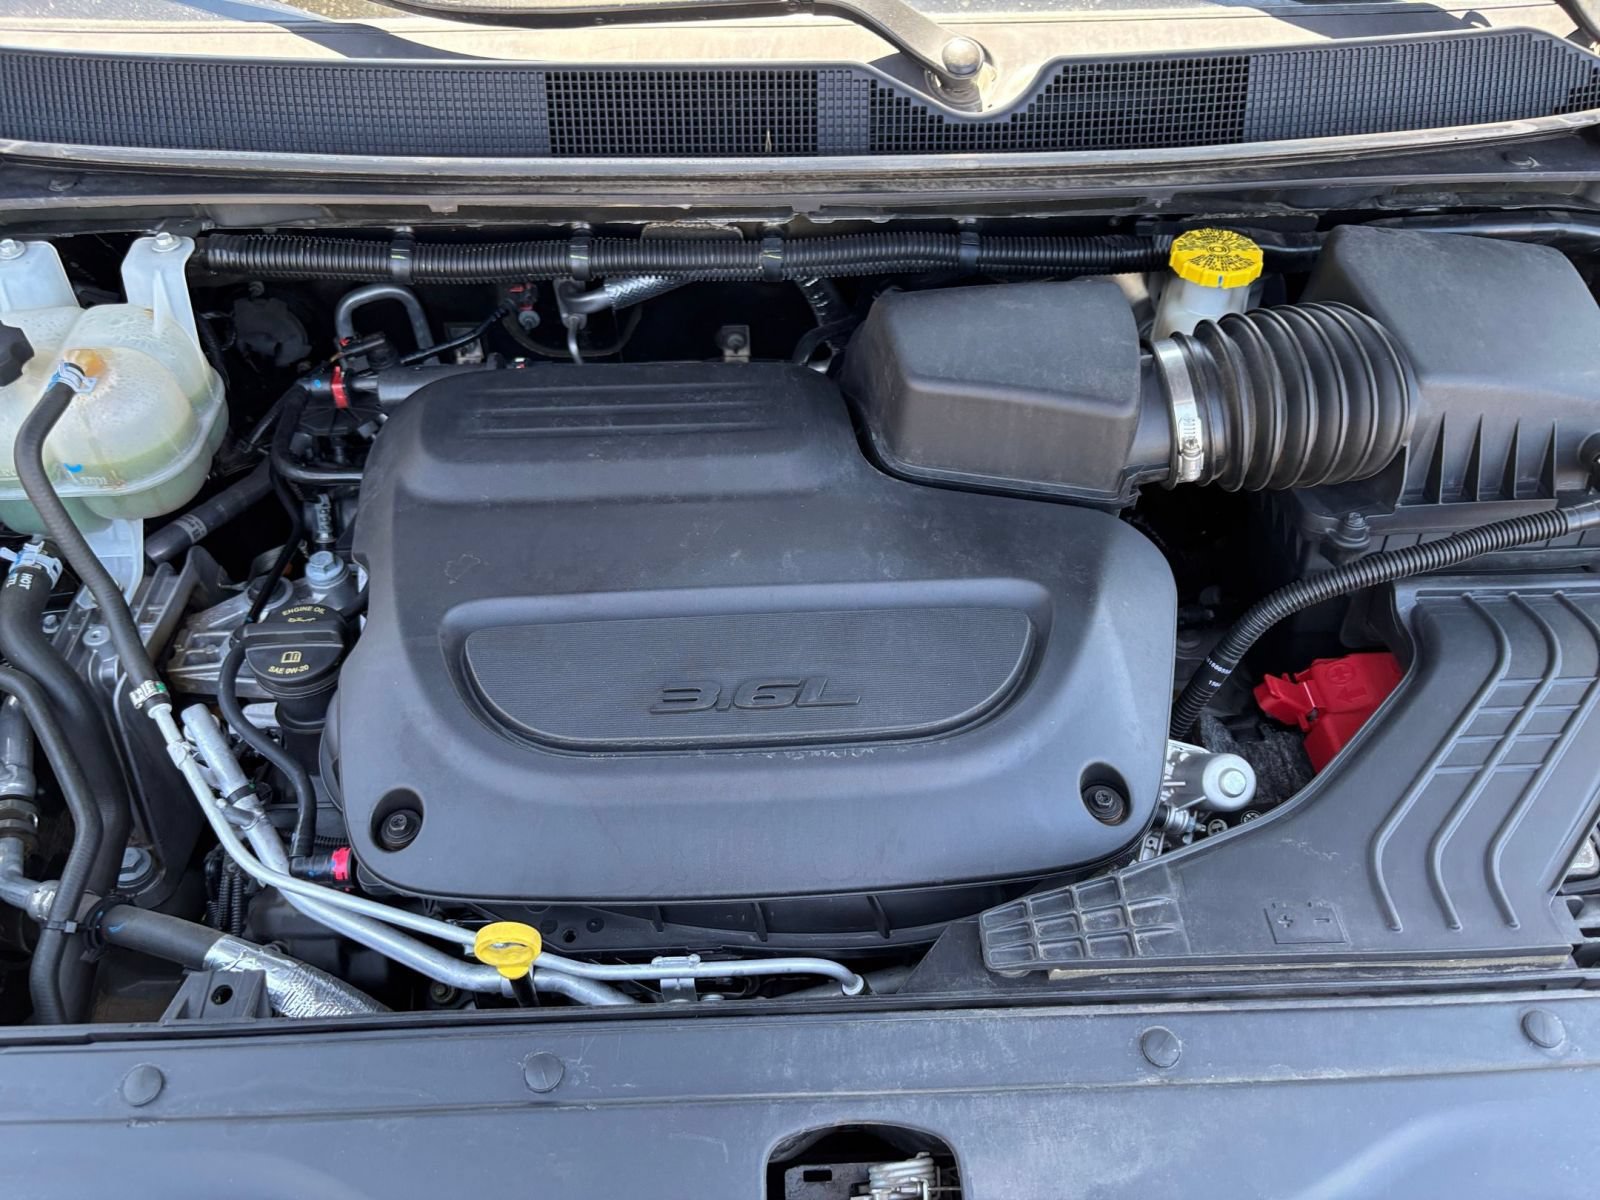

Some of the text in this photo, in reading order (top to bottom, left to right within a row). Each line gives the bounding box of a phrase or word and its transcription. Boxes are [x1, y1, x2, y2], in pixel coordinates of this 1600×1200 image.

[19, 572, 34, 590] HOT
[282, 606, 326, 616] ENGINE OIL
[268, 664, 310, 674] SAE 0W-20
[650, 680, 860, 714] 3.6L
